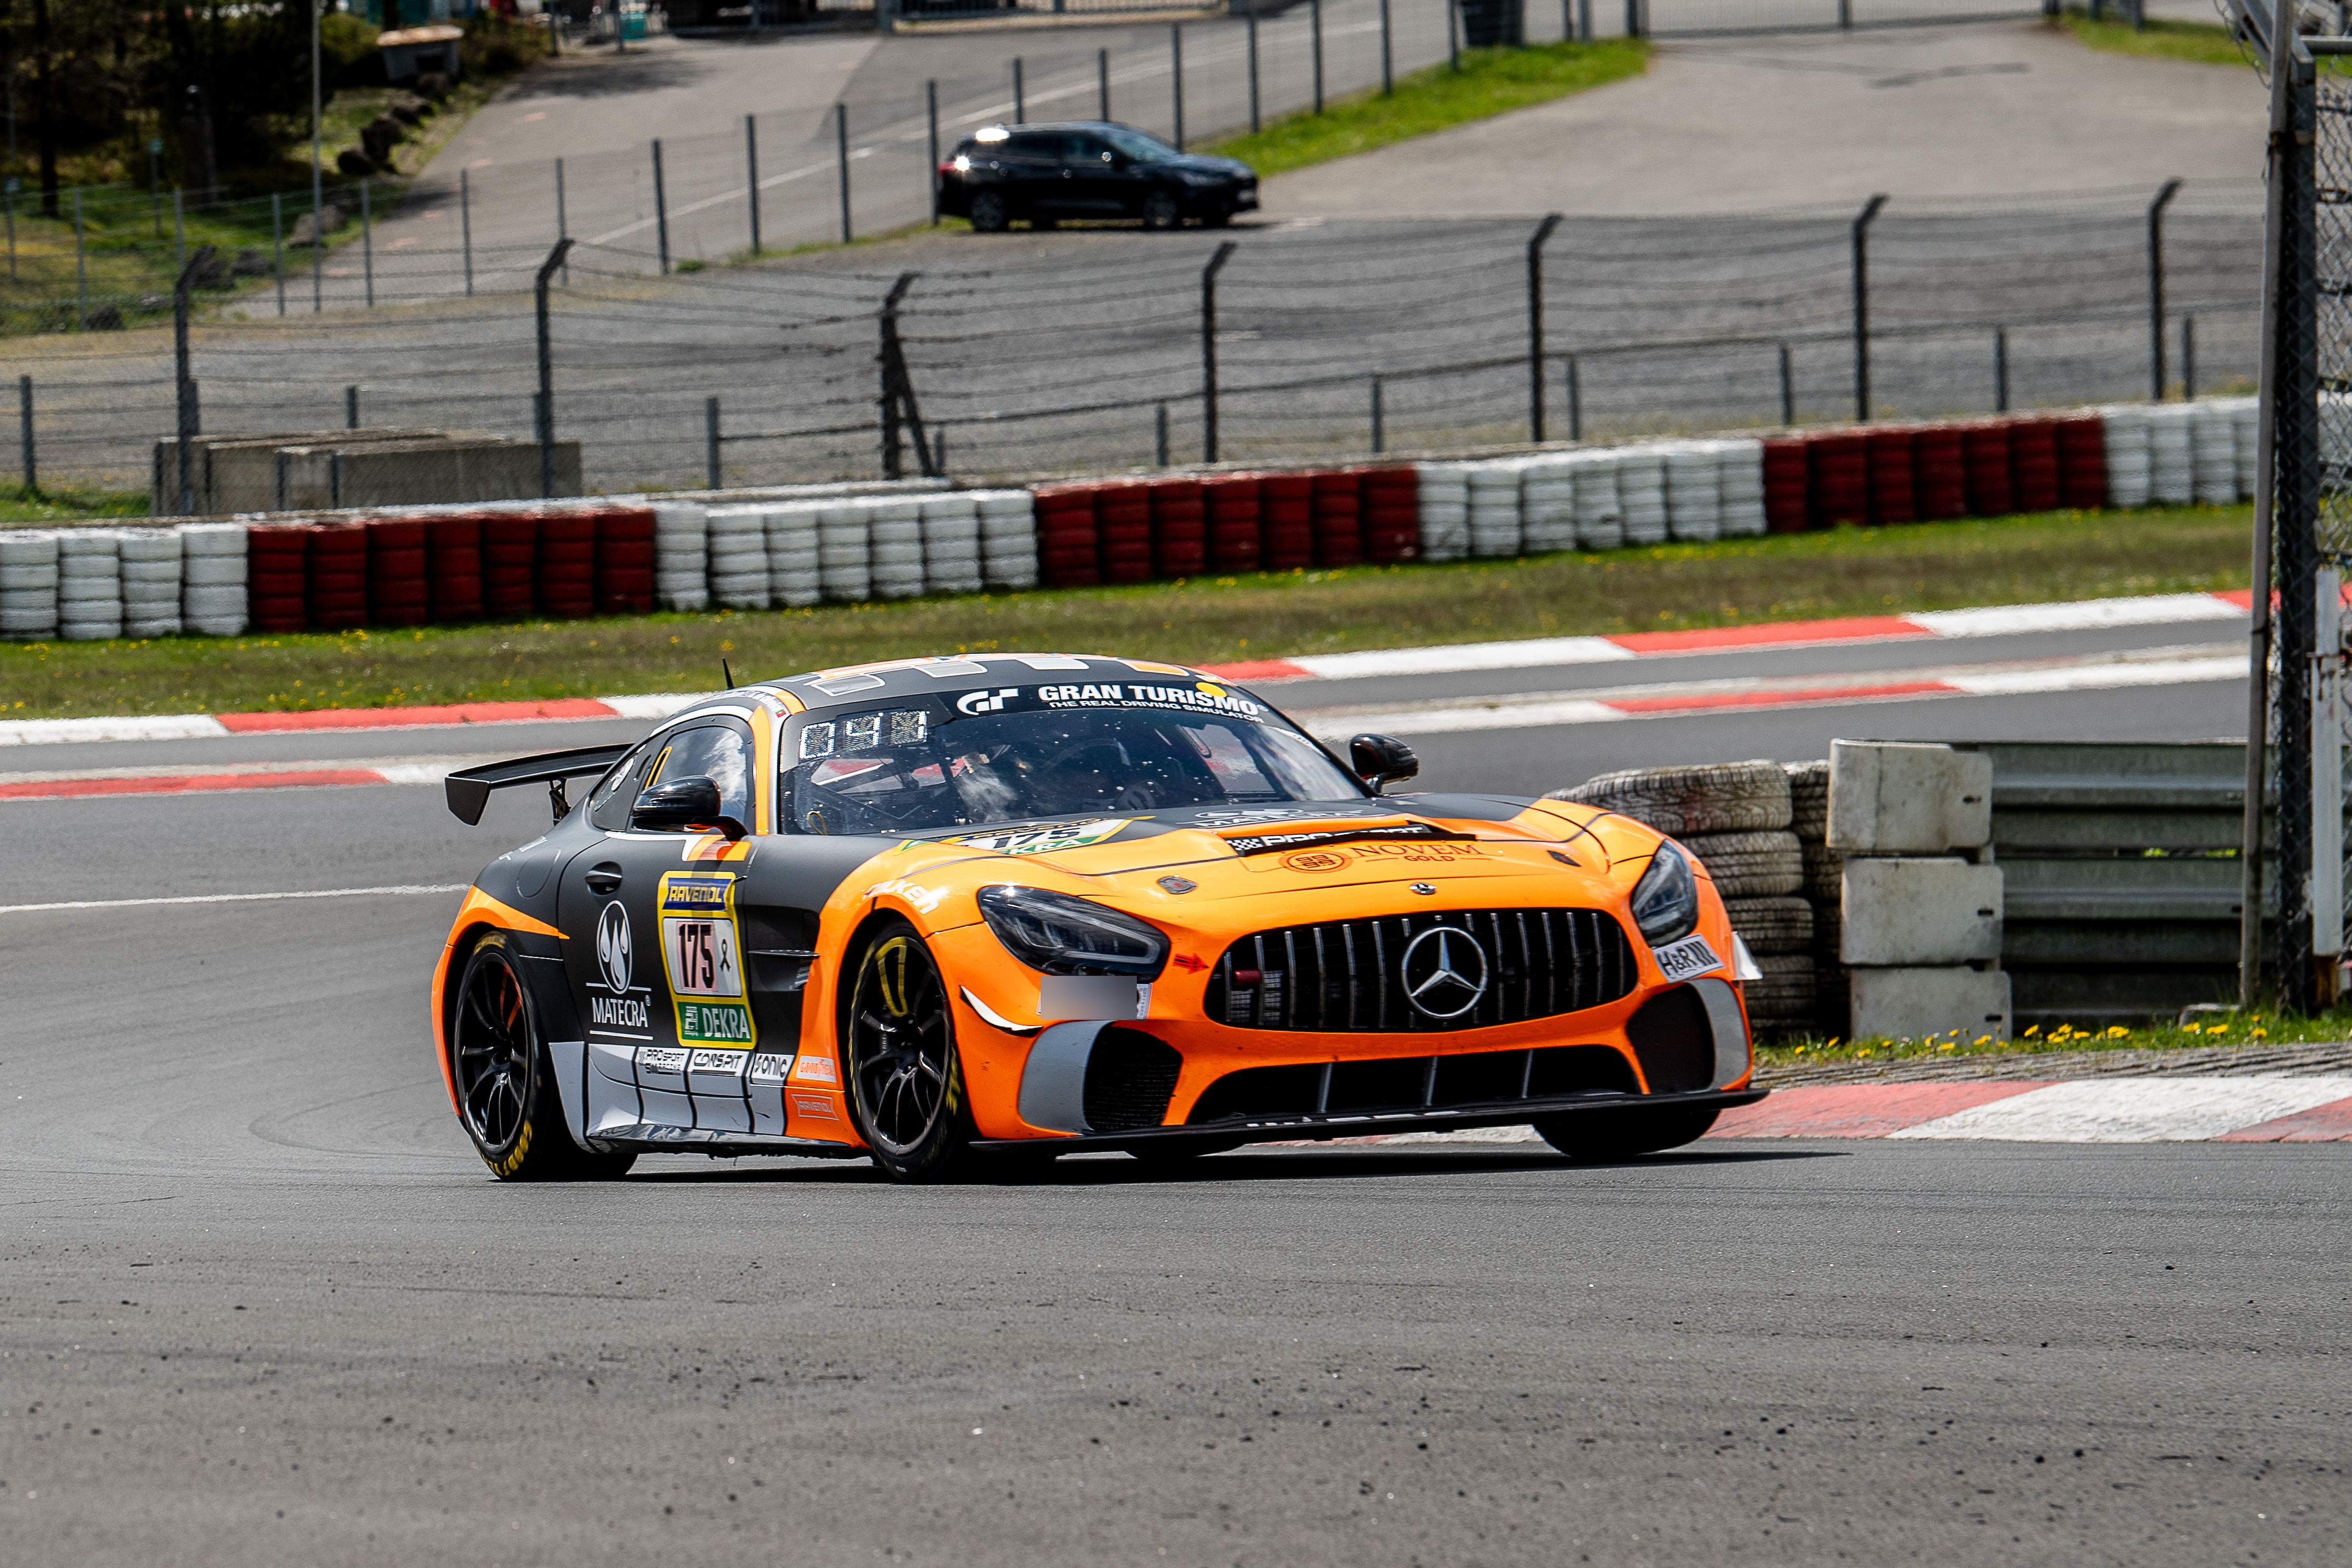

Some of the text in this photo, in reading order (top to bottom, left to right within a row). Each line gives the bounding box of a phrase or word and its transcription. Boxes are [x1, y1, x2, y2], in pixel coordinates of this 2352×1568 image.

[1038, 685, 1259, 716] GRAN TURISMO
[1121, 700, 1181, 710] DRIVING
[1182, 705, 1265, 724] SIMULATOR
[993, 827, 1081, 849] 175
[998, 839, 1082, 855] KRA
[1350, 845, 1483, 857] NOVEM
[668, 886, 722, 903] RAVENOL
[679, 924, 714, 989] 175
[1657, 947, 1698, 976] H&R
[702, 1007, 751, 1039] DEKRA
